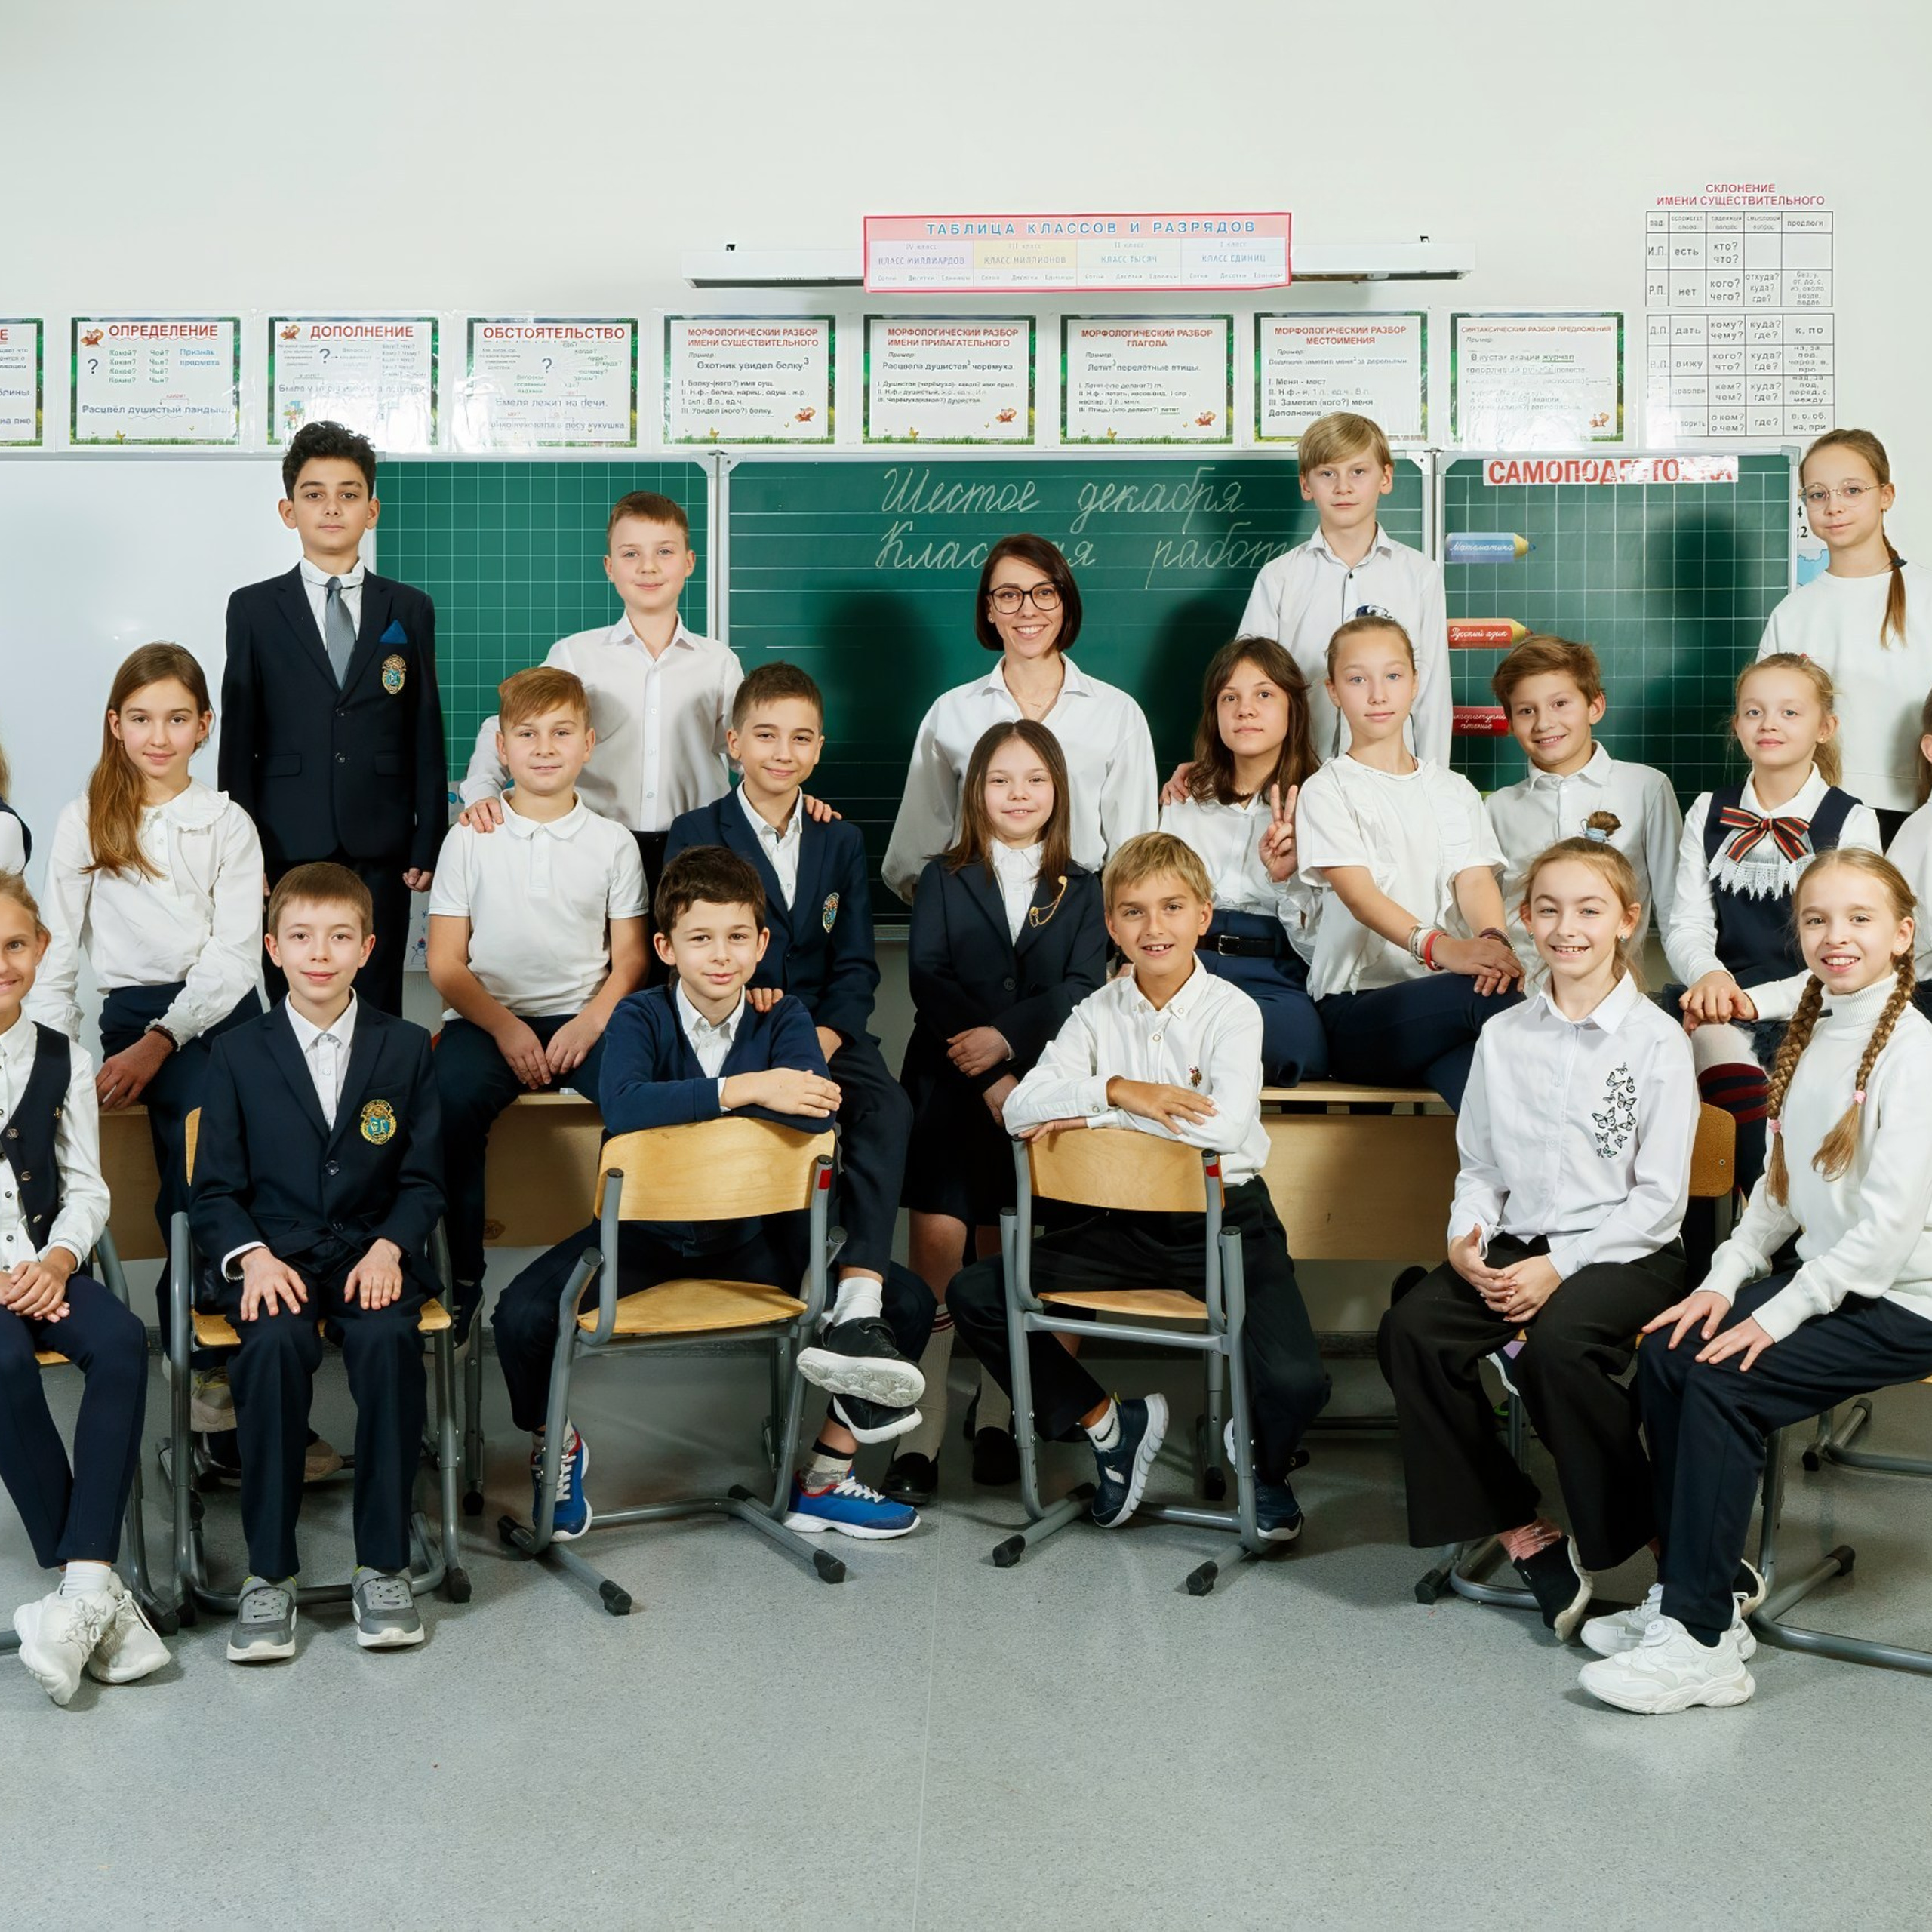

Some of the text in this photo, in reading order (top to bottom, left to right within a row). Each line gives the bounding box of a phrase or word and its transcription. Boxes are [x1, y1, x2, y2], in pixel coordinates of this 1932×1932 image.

[1706, 184, 1775, 193] СКЛОНЕНИЕ
[1657, 196, 1825, 206] ИМЕНИ СУЩЕСТВИТЕЛЬНОГО
[926, 221, 1255, 236] ТАБЛИЦА КЛАССОВ И РАЗРЯДОВ
[1713, 242, 1738, 251] кто?
[1647, 246, 1666, 257] И.П.
[1674, 248, 1699, 257] есть
[878, 257, 964, 266] КЛАСС МИЛЛИАРДОВ
[1131, 255, 1158, 263] ТЫСЯЧ
[1713, 255, 1739, 264] что?
[1710, 278, 1740, 288] кого?
[1649, 285, 1666, 296] Р.П.
[1749, 284, 1775, 293] куда?
[1710, 291, 1740, 301] чего?
[1752, 295, 1772, 303] где?
[1710, 320, 1743, 329] кому?
[1749, 320, 1782, 329] куда?
[109, 325, 218, 338] ОПРЕДЕЛЕНИЕ
[310, 325, 414, 340] ДОПОЛНЕНИЕ
[483, 328, 625, 340] ОБСТОЯТЕЛЬСТВО
[688, 328, 780, 337] МОРФОЛОГИЧЕСКИЙ
[888, 328, 981, 337] МОРФОЛОГИЧЕСКИЙ
[1081, 328, 1214, 337] МОРФОЛОГИЧЕСКИЙ РАЗБОР
[1275, 326, 1407, 335] МОРФОЛОГИЧЕСКИЙ РАЗБОР
[1650, 326, 1669, 335] Д.П.
[1795, 327, 1805, 337] к,
[1710, 331, 1743, 340] чему?
[1754, 331, 1778, 340] где?
[688, 339, 819, 348] ИМЕНИ СУЩЕСТВИТЕЛЬНОГО
[888, 339, 1010, 347] ИМЕНИ ПРИЛАГАТЕЛЬНОГО
[1306, 337, 1376, 346] МЕСТОИМЕНИЯ
[180, 348, 216, 357] Признак
[1712, 352, 1743, 360] кого?
[1751, 352, 1782, 361] куда?
[697, 361, 737, 370] Охотник
[738, 362, 773, 371] увидел
[883, 362, 924, 371] Расцвела
[1675, 361, 1703, 370] вижу
[1715, 363, 1740, 371] что?
[1754, 362, 1778, 371] где?
[1715, 383, 1742, 391] кем?
[1749, 383, 1782, 392] куда?
[1754, 393, 1778, 401] где?
[1320, 398, 1349, 408] (кого?)
[128, 405, 182, 415] душистый
[1269, 409, 1322, 417] Дополнение
[1719, 423, 1745, 432] чем?
[1809, 424, 1826, 433] при
[881, 467, 1245, 534] Шестое декабря
[1450, 541, 1514, 551] Математика
[1145, 522, 1287, 589] работ
[1451, 626, 1508, 640] Русский язык
